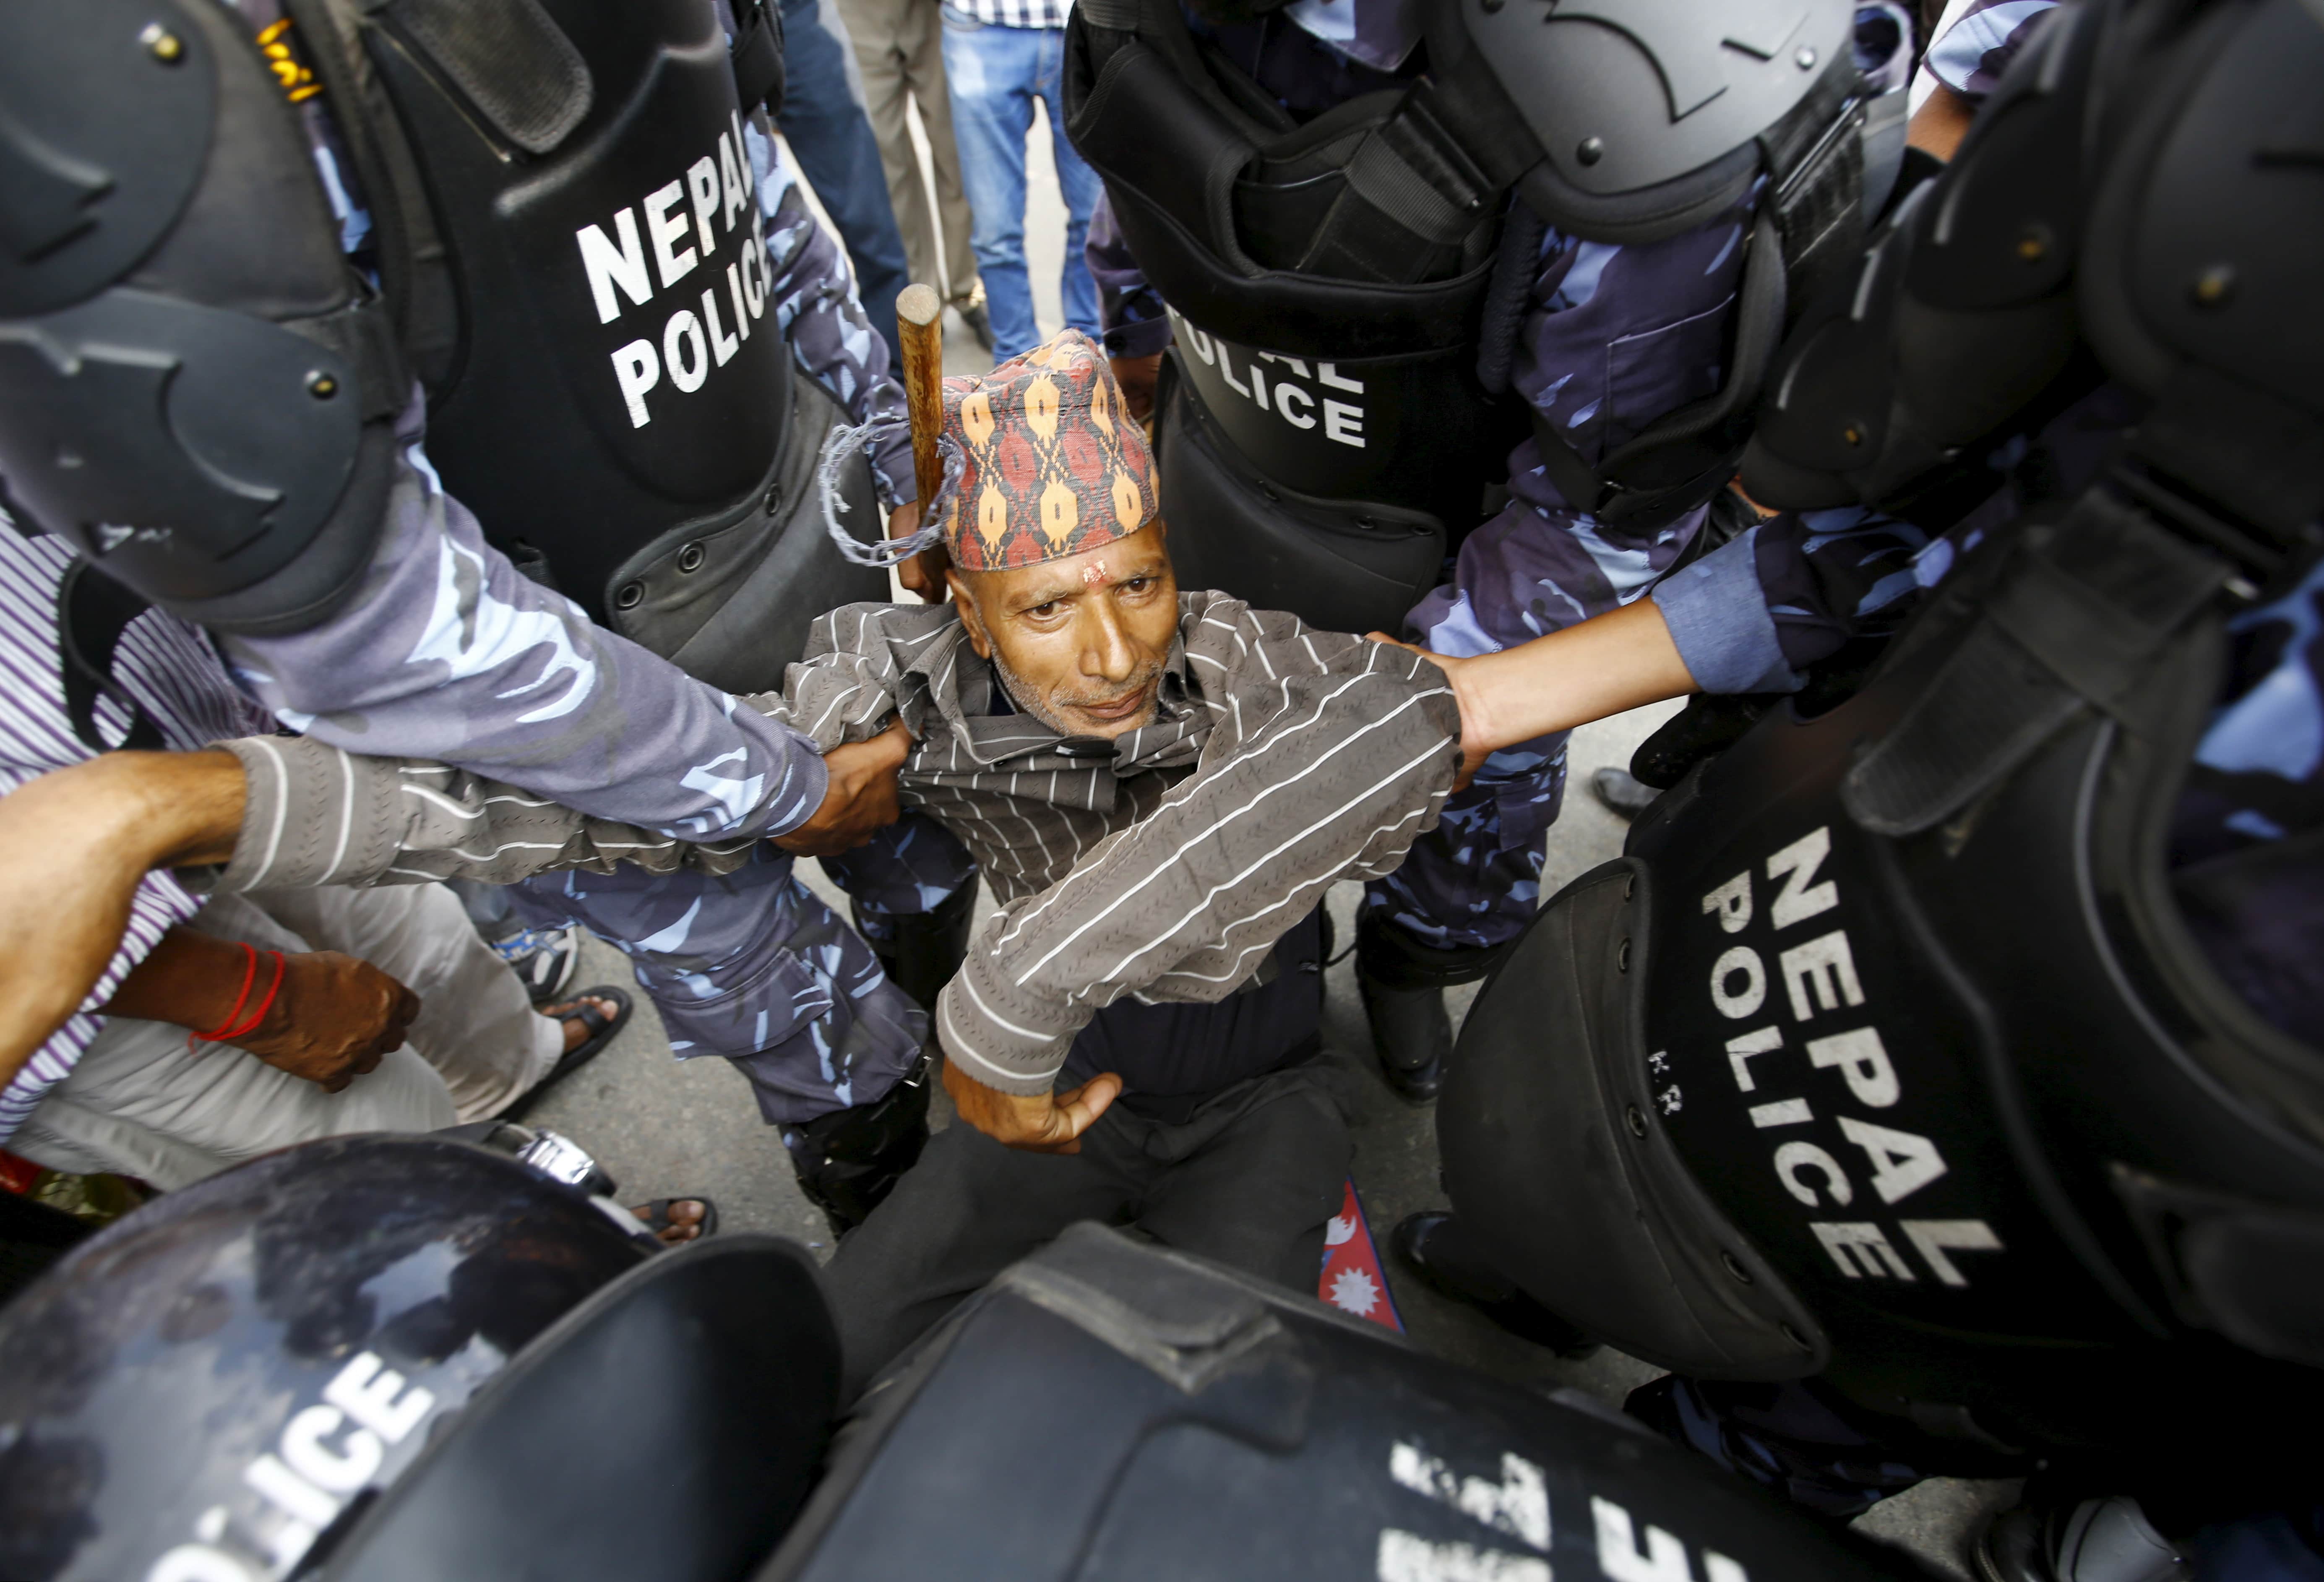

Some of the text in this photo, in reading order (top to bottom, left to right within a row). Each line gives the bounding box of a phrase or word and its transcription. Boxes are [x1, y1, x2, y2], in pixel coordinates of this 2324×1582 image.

[576, 108, 753, 324] NEPAL
[610, 207, 773, 429] POLICE
[1164, 302, 1365, 448] OLICE
[1702, 870, 1916, 1282] POLICE
[1766, 826, 2004, 1287] NEPAL
